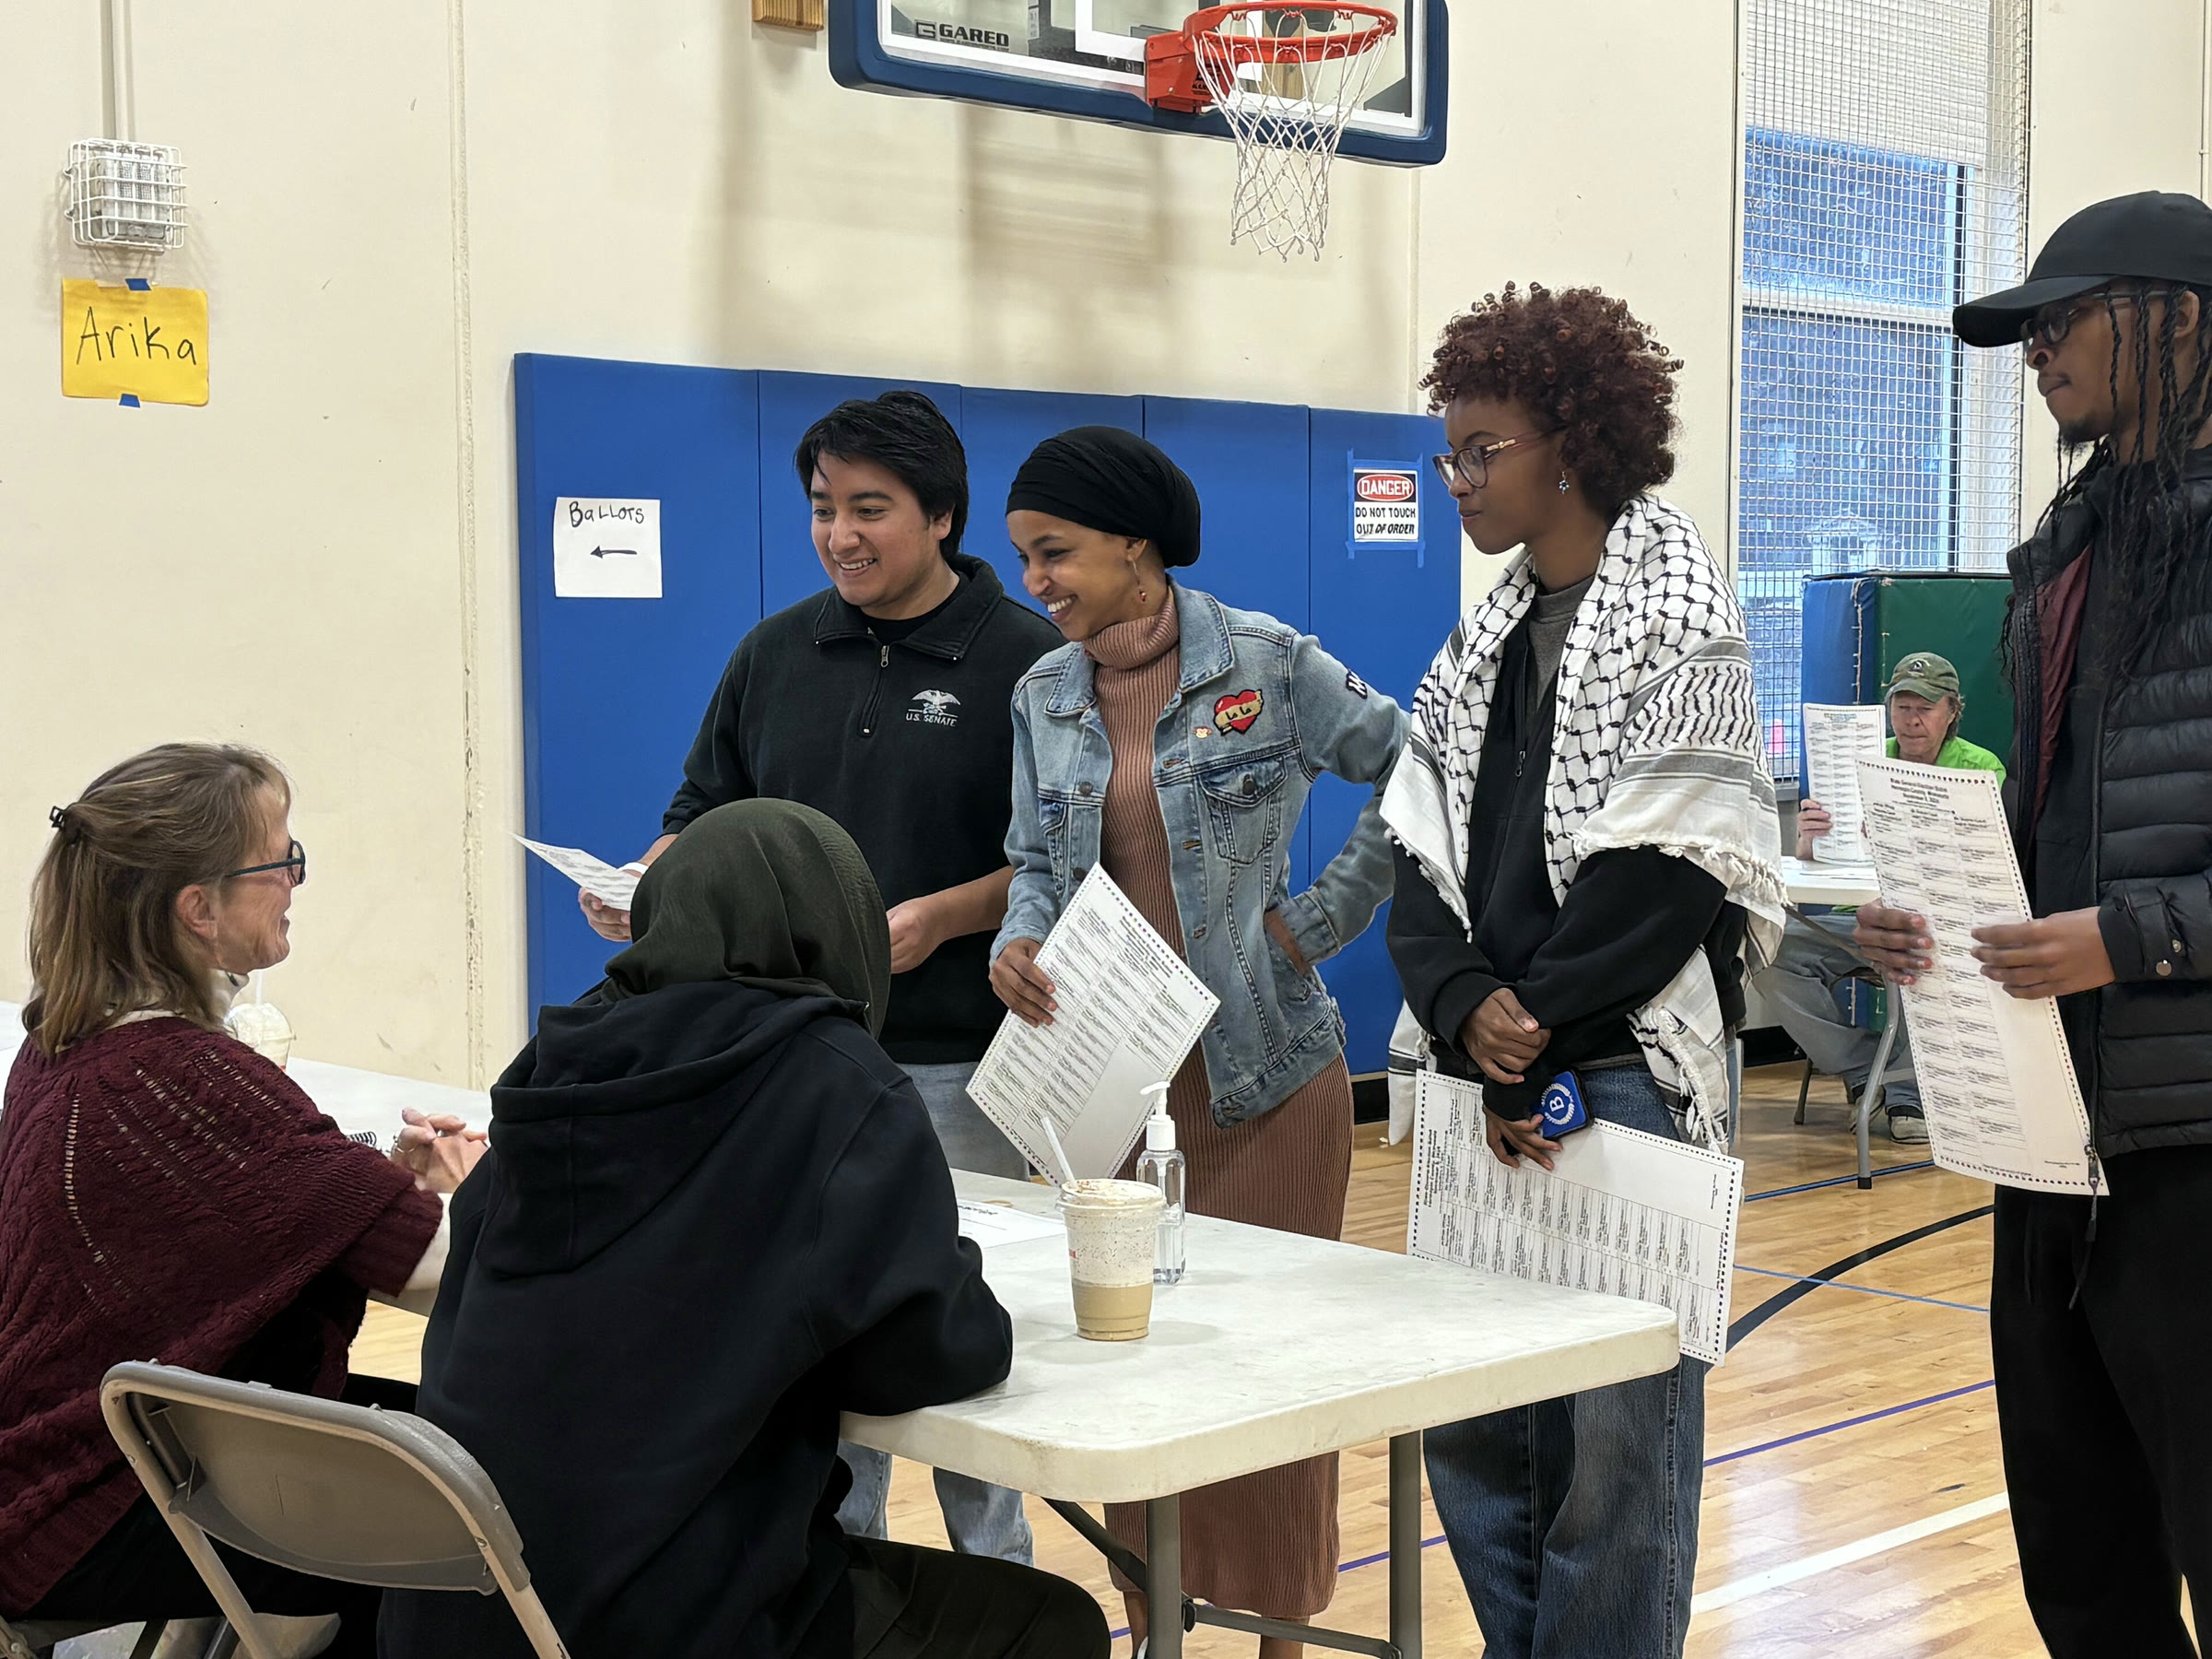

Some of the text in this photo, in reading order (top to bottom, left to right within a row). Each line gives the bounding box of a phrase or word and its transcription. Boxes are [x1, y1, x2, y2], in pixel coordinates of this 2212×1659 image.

[939, 23, 1009, 47] GARED
[76, 306, 196, 365] Arika
[1361, 479, 1410, 496] DANGER
[1355, 507, 1416, 518] DO NOT TOUCH
[1356, 524, 1416, 535] OUT OF ORDER
[1549, 1096, 1565, 1112] B
